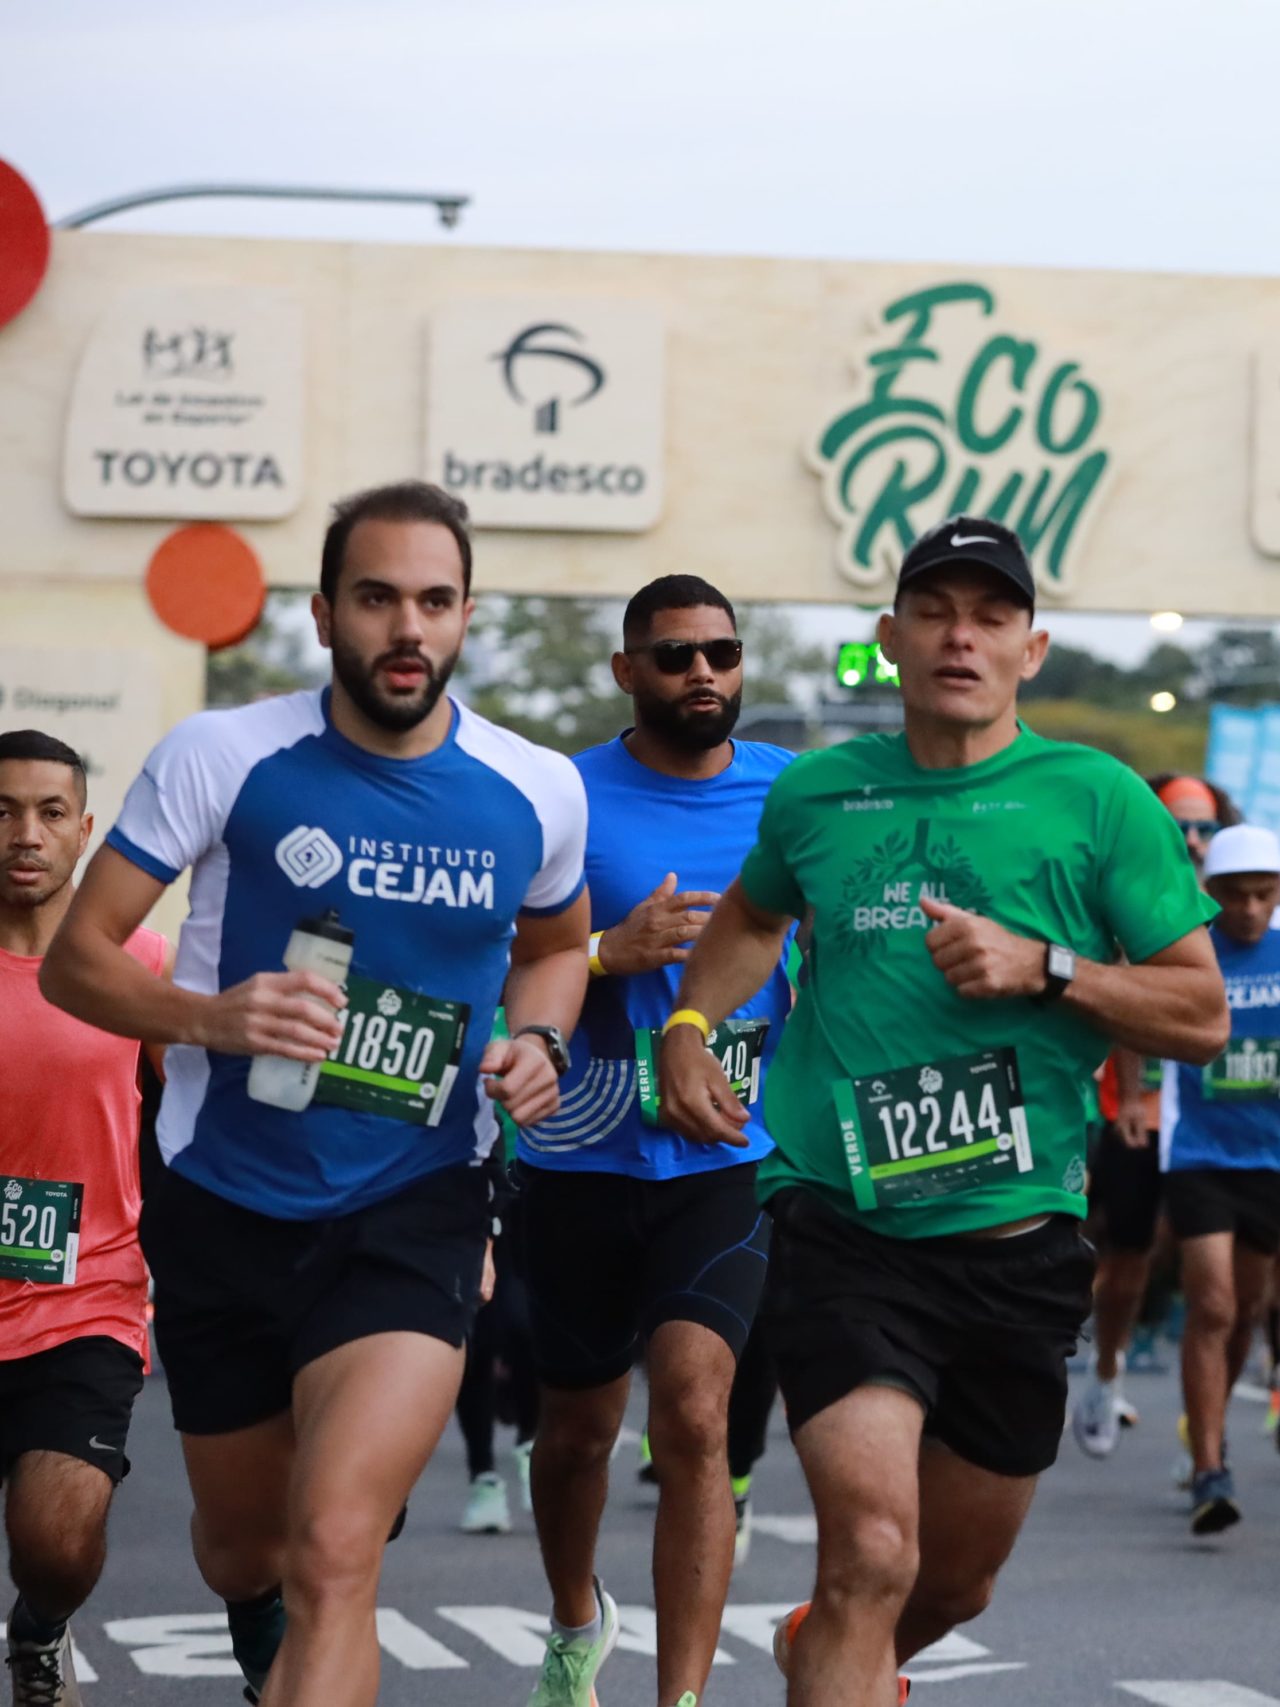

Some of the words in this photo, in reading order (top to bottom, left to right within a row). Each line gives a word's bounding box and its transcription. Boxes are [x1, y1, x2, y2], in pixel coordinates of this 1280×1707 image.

[96, 450, 284, 489] TOYOTA
[444, 451, 645, 495] bradesco
[350, 834, 495, 869] INSTITUTO
[347, 858, 494, 910] CEJAM
[883, 882, 911, 903] WE
[919, 881, 949, 901] ALL
[853, 905, 940, 931] BREA
[638, 1059, 651, 1102] VERDE
[878, 1083, 1002, 1160] 12244
[840, 1119, 863, 1176] VERDE
